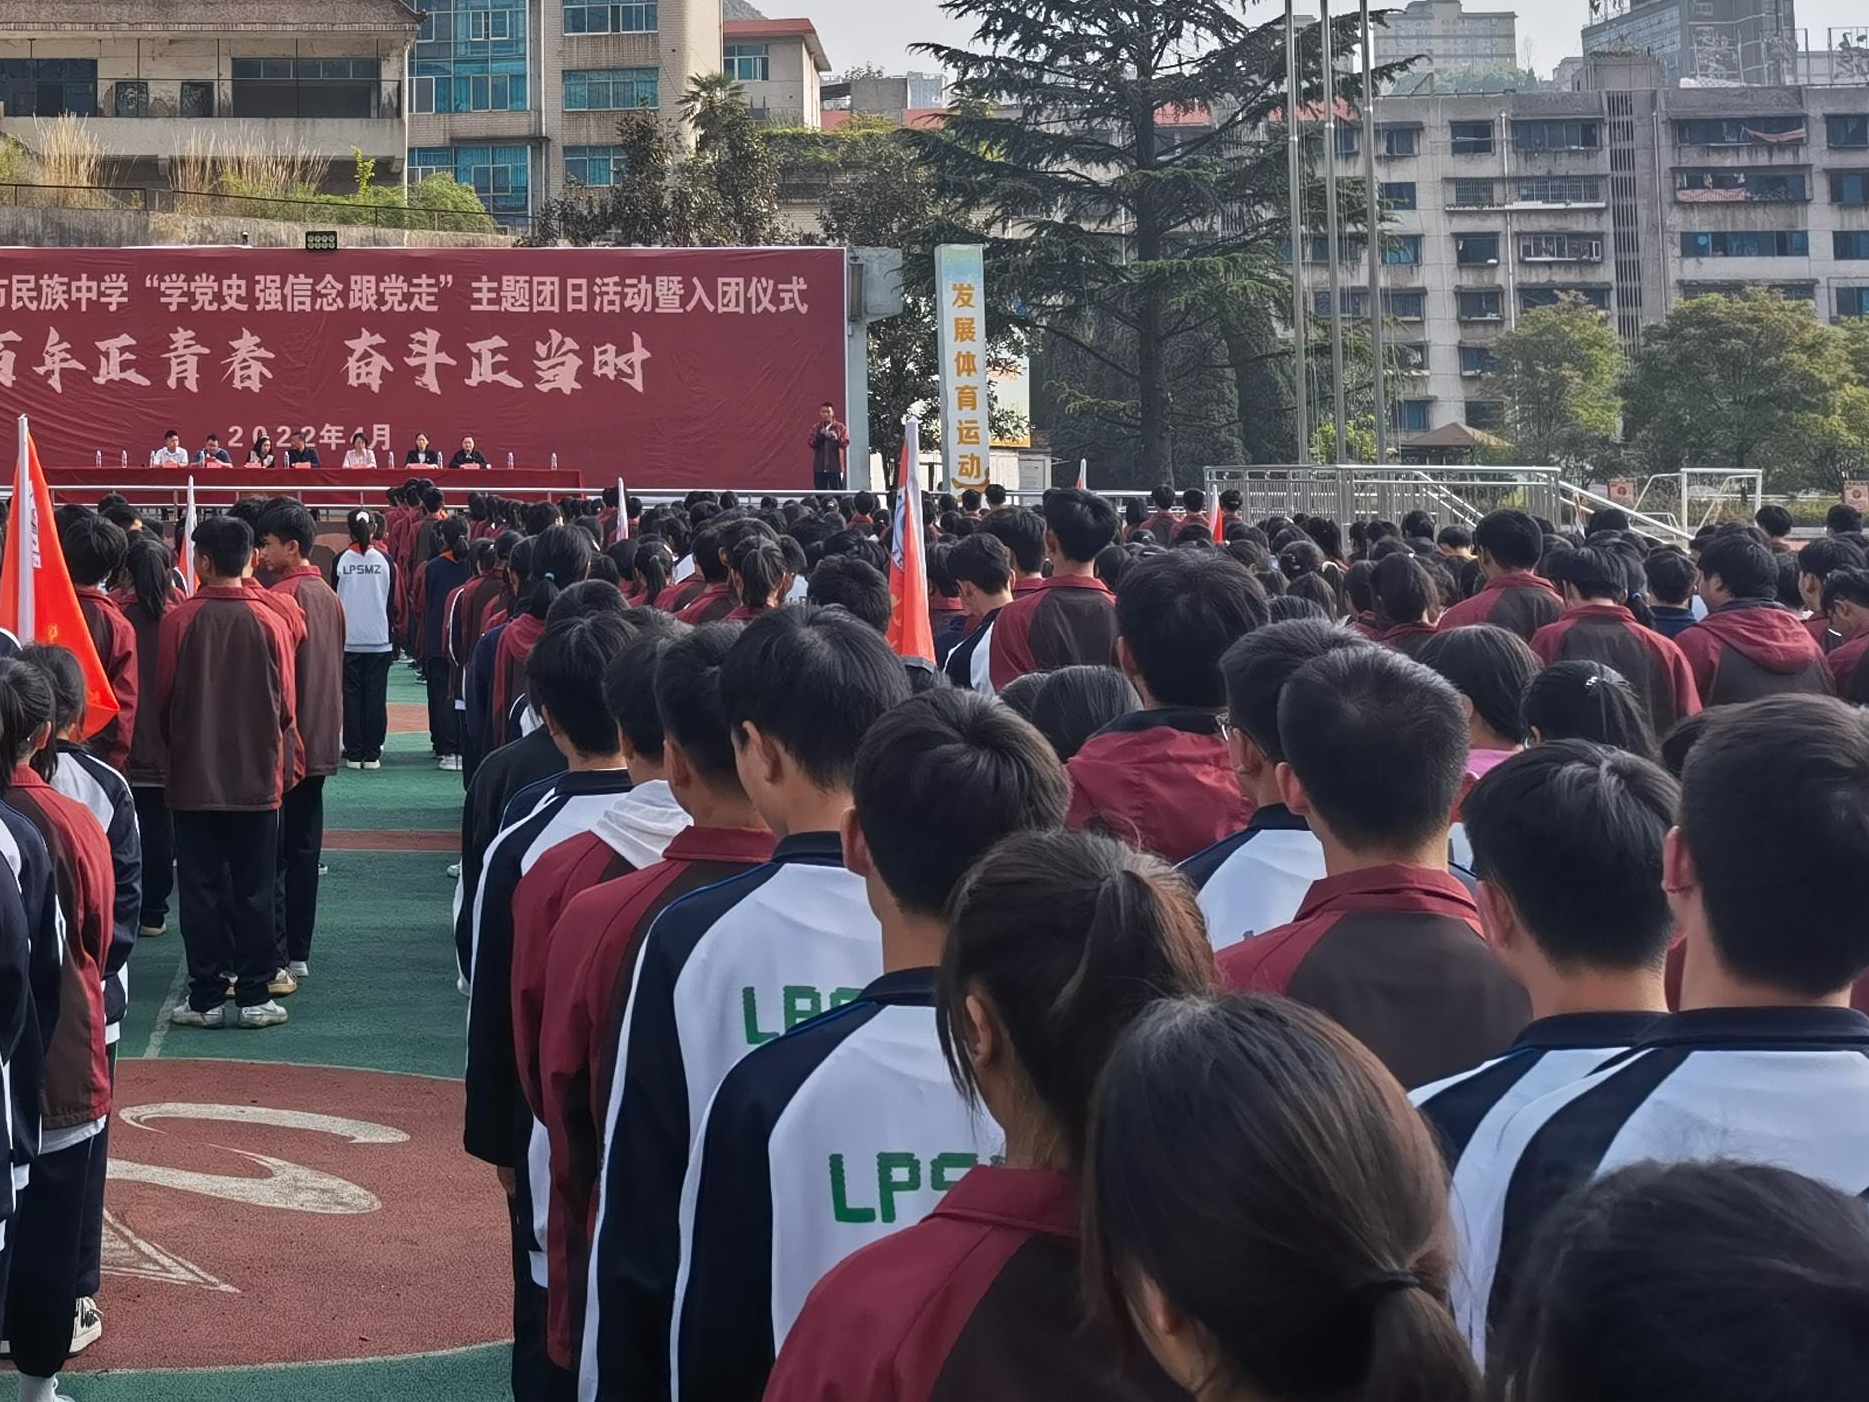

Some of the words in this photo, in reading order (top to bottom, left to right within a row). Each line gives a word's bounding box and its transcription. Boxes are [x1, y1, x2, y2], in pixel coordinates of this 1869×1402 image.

[255, 273, 345, 312] 强信念
[470, 274, 809, 315] 主题团日活动暨入团仪式
[343, 327, 652, 395] 奋斗正当时
[952, 283, 982, 478] 发展体育运动
[343, 564, 381, 575] LPSMZ
[829, 1151, 1004, 1223] LPS
